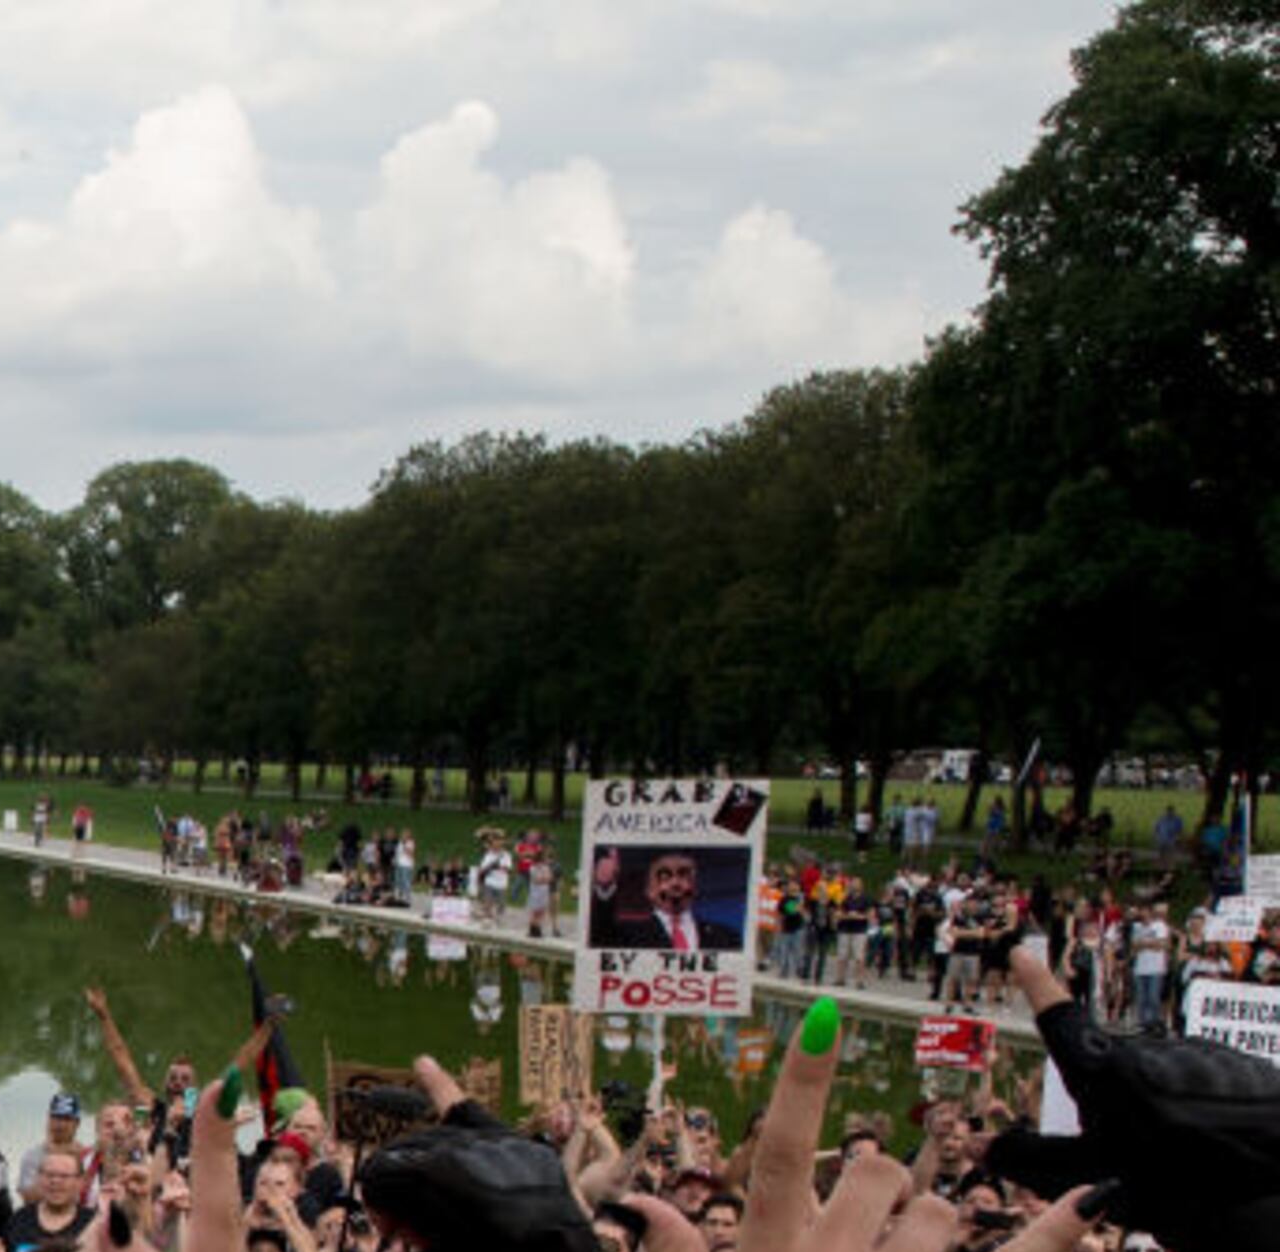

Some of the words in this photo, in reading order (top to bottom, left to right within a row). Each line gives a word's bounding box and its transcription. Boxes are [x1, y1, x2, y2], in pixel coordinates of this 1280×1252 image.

[604, 780, 715, 806] GRAB
[594, 812, 710, 833] AMERICA
[600, 952, 636, 972] BY
[658, 952, 718, 972] THE
[598, 974, 739, 1009] POSSE
